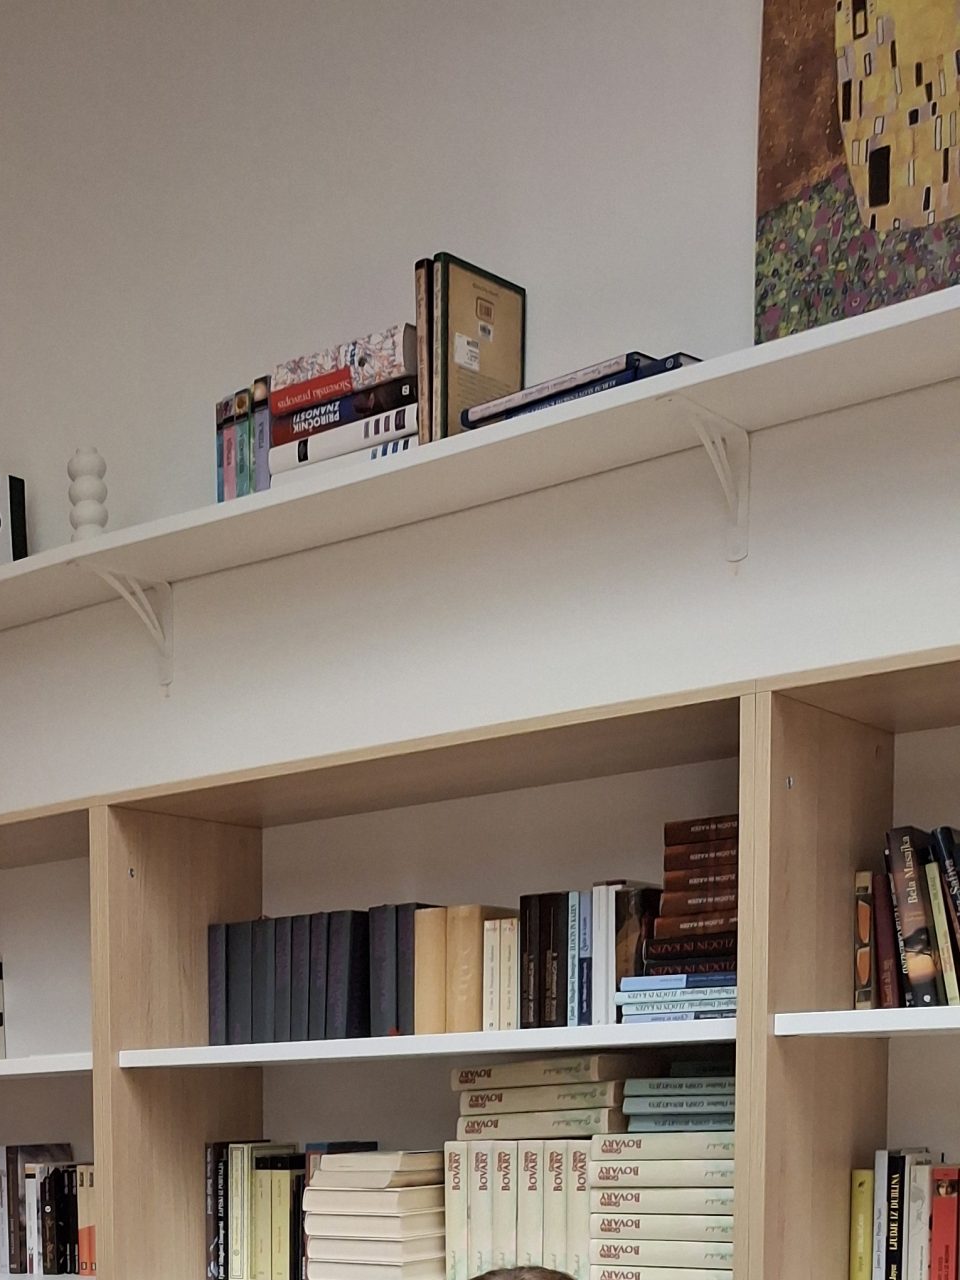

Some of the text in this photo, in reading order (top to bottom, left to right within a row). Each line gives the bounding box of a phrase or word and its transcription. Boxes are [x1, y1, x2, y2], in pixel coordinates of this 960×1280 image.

[278, 380, 351, 409] Slovenski pravopis
[293, 401, 340, 422] ZNANOSTI
[293, 411, 340, 433] PRIROČNIK
[900, 835, 919, 904] Bela Masajka
[649, 939, 733, 954] ZLOČIN IN KAZEN
[650, 961, 735, 975] ZLOČIN IN KAZEN
[635, 1004, 654, 1012] KAZEN
[663, 1003, 685, 1011] ZLOČIN
[459, 1068, 492, 1079] BOVARY
[469, 1093, 502, 1103] BOVARY
[465, 1119, 498, 1129] BOVARY
[601, 1140, 642, 1149] BOVARY
[452, 1152, 460, 1190] BOVARY
[479, 1152, 488, 1190] BOVARY
[502, 1152, 510, 1190] BOVARY
[528, 1152, 537, 1190] BOVARY
[554, 1152, 562, 1190] BOVARY
[577, 1152, 586, 1190] BOVARY
[598, 1166, 639, 1176] BOVARY
[600, 1192, 640, 1202] BOVARY
[890, 1173, 899, 1208] DUBLINA
[890, 1210, 899, 1219] IZ
[600, 1219, 640, 1228] BOVARY
[889, 1221, 899, 1250] LJUDJE
[600, 1245, 640, 1255] BOVARY
[600, 1270, 640, 1280] BOVARY
[889, 1264, 898, 1280] Joyce
